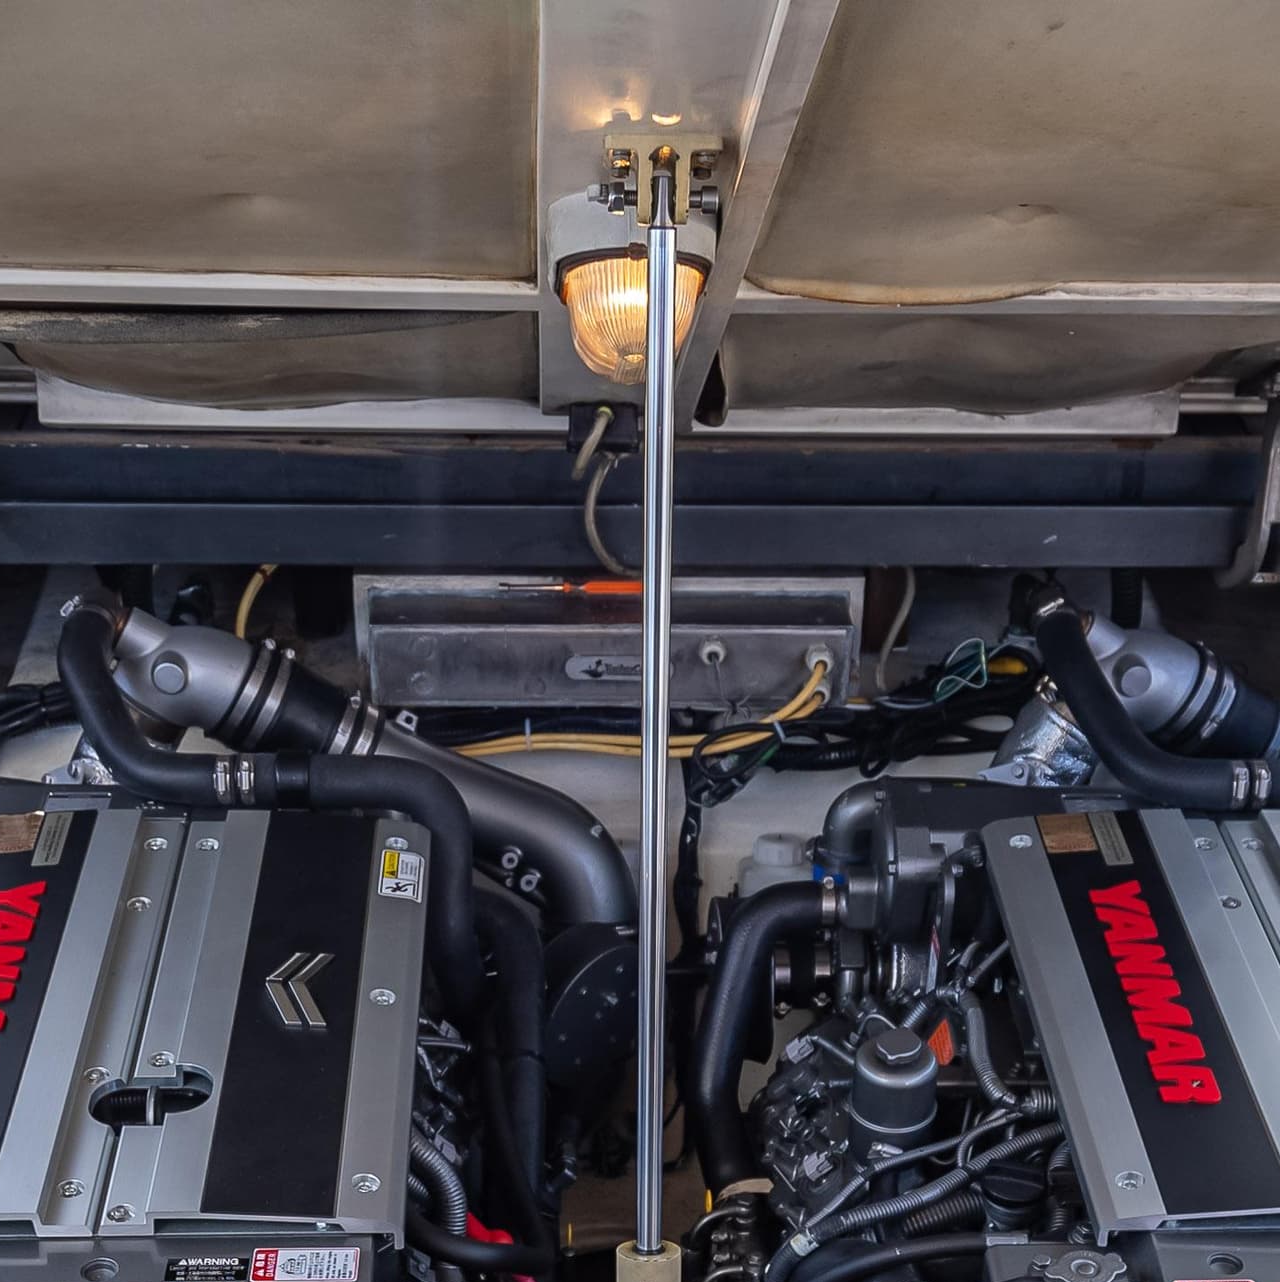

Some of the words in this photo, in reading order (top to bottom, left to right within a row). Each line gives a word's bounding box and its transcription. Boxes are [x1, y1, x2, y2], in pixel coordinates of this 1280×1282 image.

[1089, 880, 1222, 1104] YANMAR
[187, 1258, 239, 1266] WARNING
[266, 1253, 275, 1278] DANGER
